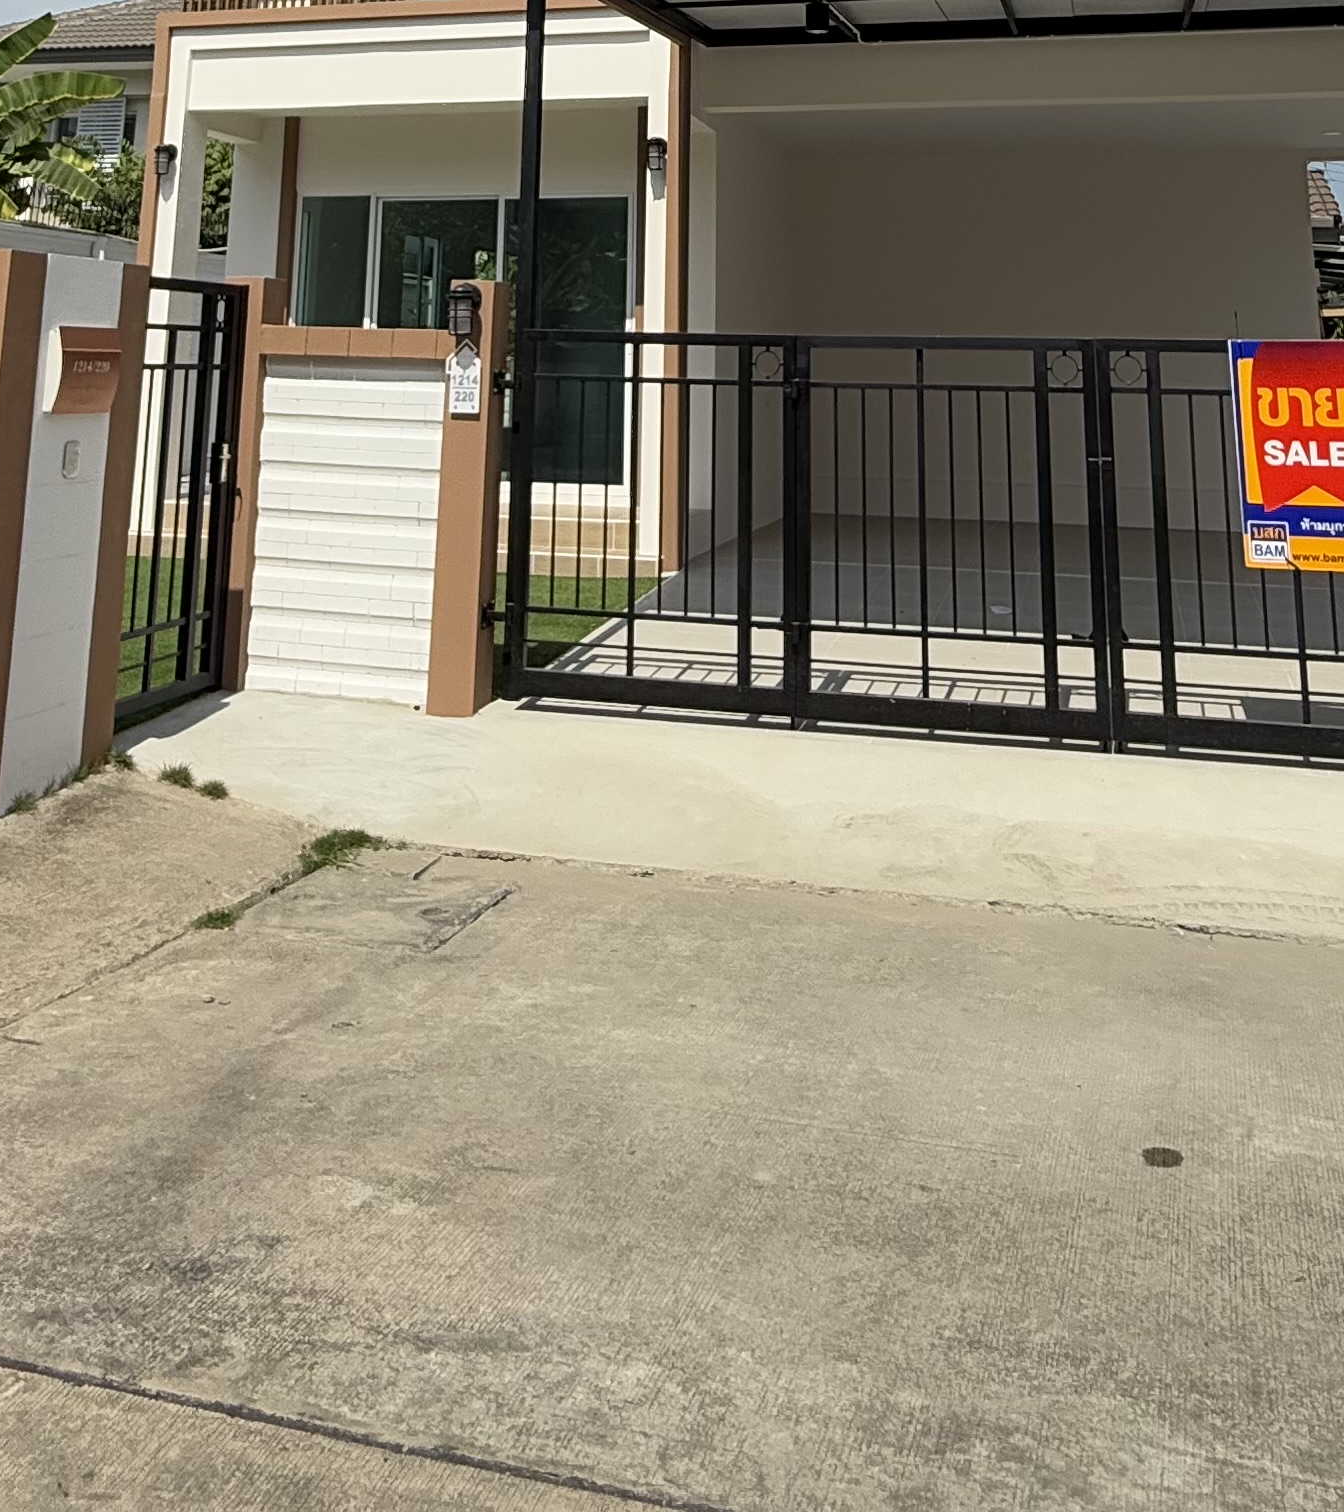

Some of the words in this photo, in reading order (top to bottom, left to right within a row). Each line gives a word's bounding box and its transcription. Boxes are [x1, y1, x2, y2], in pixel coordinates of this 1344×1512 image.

[72, 360, 111, 373] 1214/220
[452, 374, 479, 385] 1214
[454, 391, 475, 402] 220
[1251, 525, 1285, 541] บสก
[1254, 542, 1286, 558] BAM
